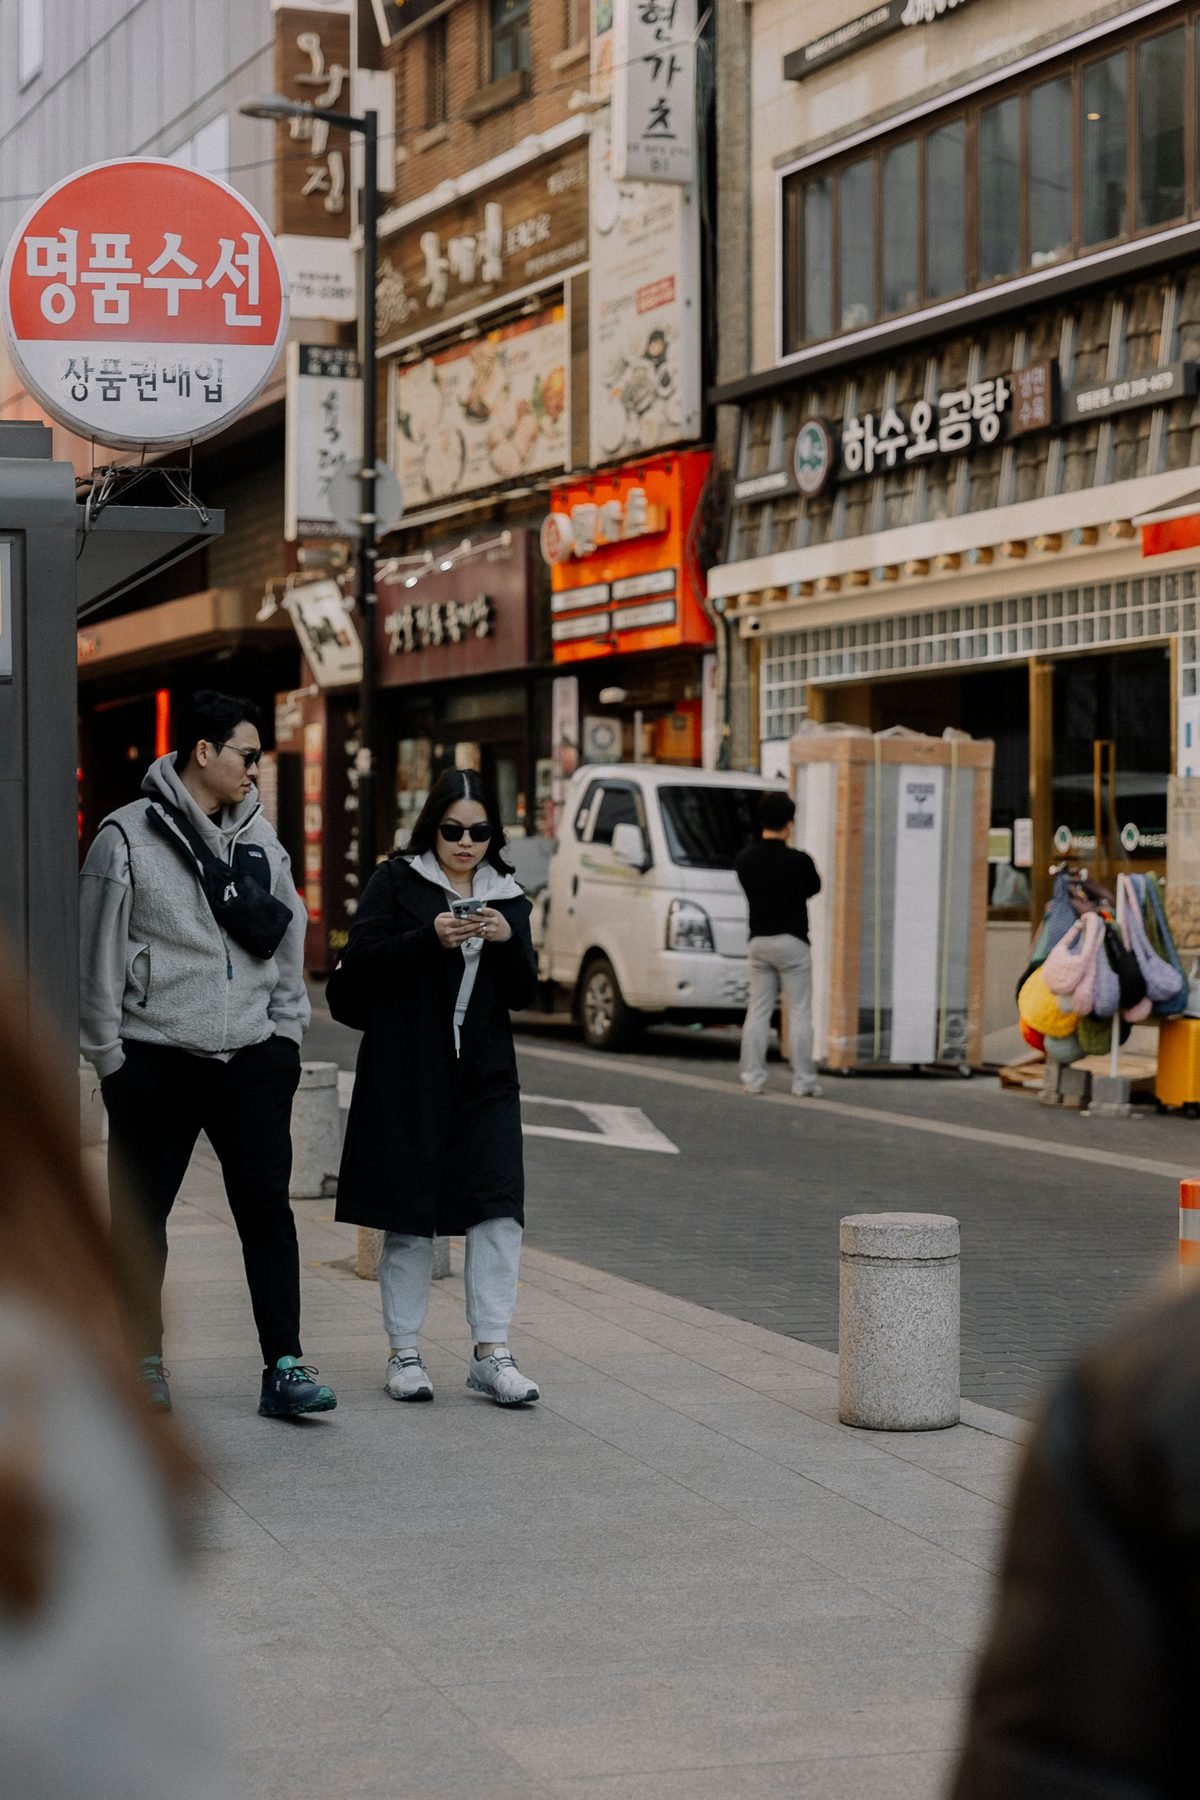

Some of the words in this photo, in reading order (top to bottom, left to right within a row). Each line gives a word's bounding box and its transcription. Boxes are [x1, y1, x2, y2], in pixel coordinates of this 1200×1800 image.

[24, 227, 262, 327] 명품수선
[60, 355, 224, 403] 상품권매입
[842, 376, 1010, 473] 하수오곰탕
